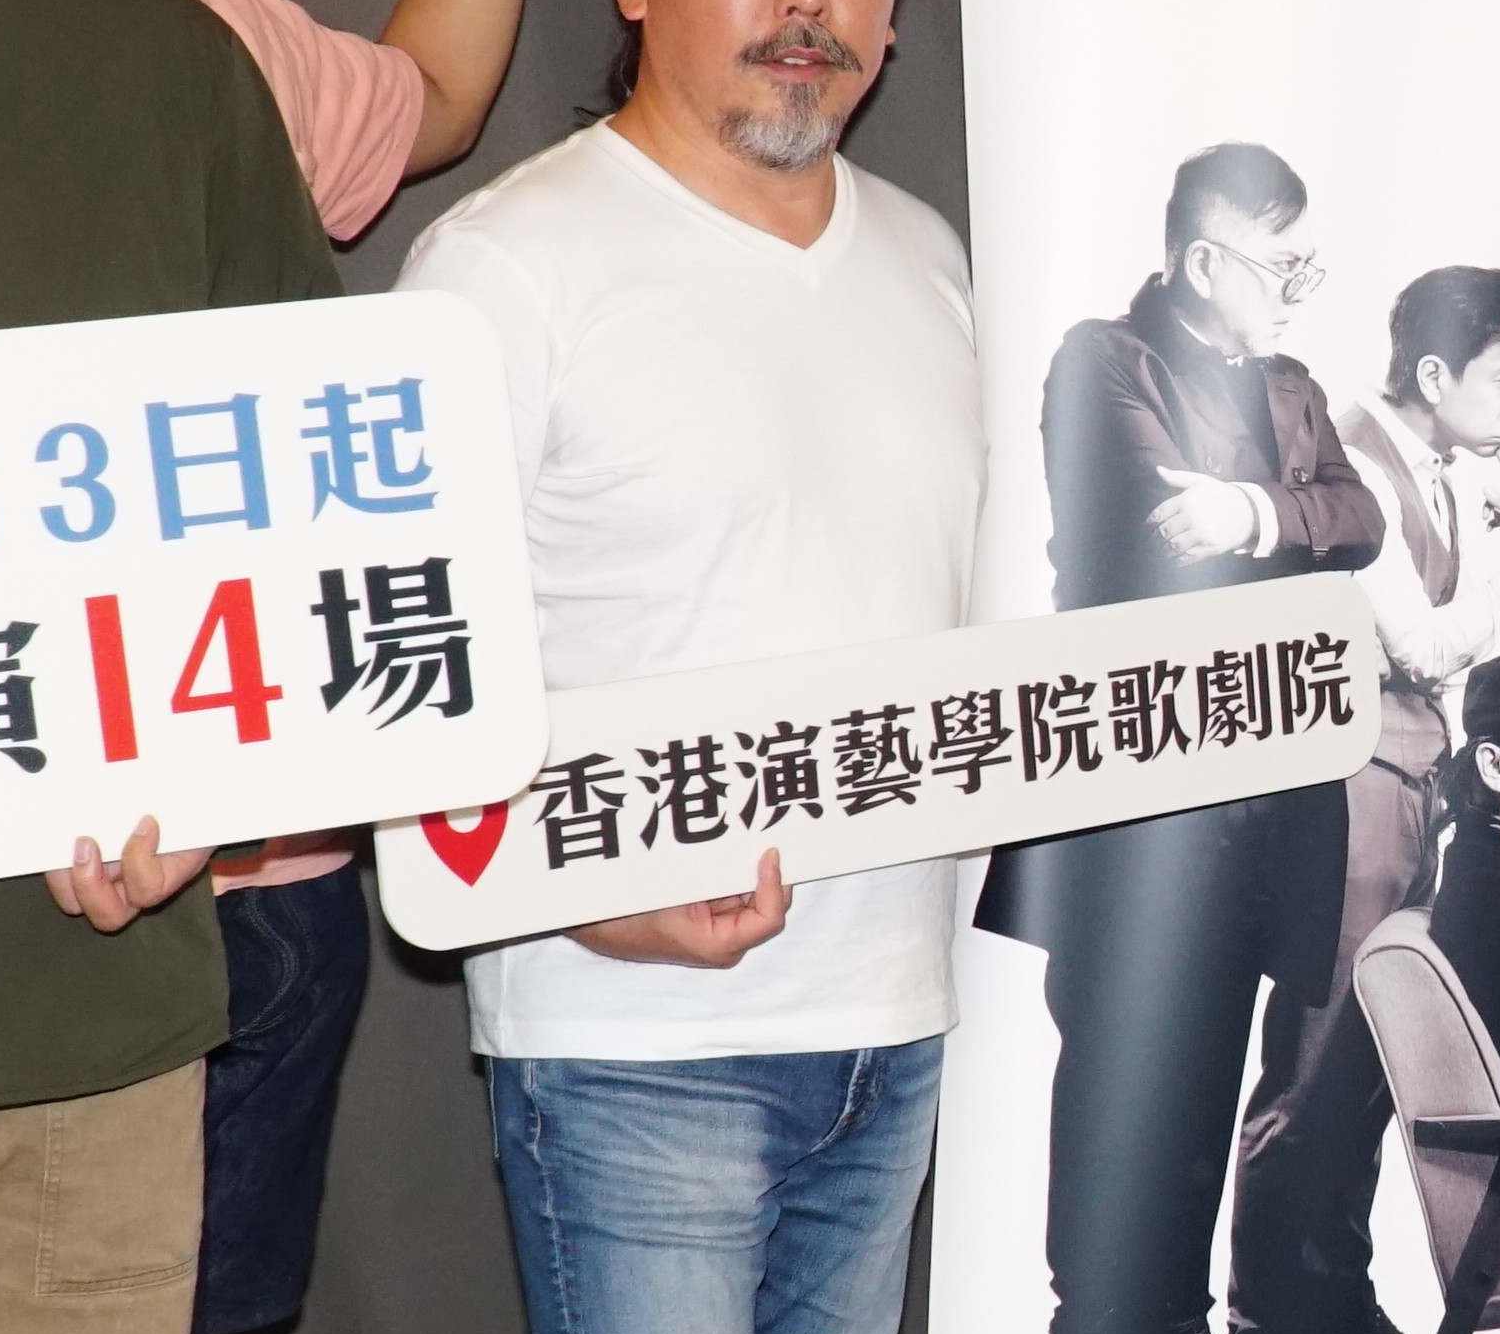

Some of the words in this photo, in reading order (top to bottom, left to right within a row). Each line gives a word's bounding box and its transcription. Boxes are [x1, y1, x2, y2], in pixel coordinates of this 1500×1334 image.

[527, 632, 1355, 870] 香港演藝學院歌劇院
